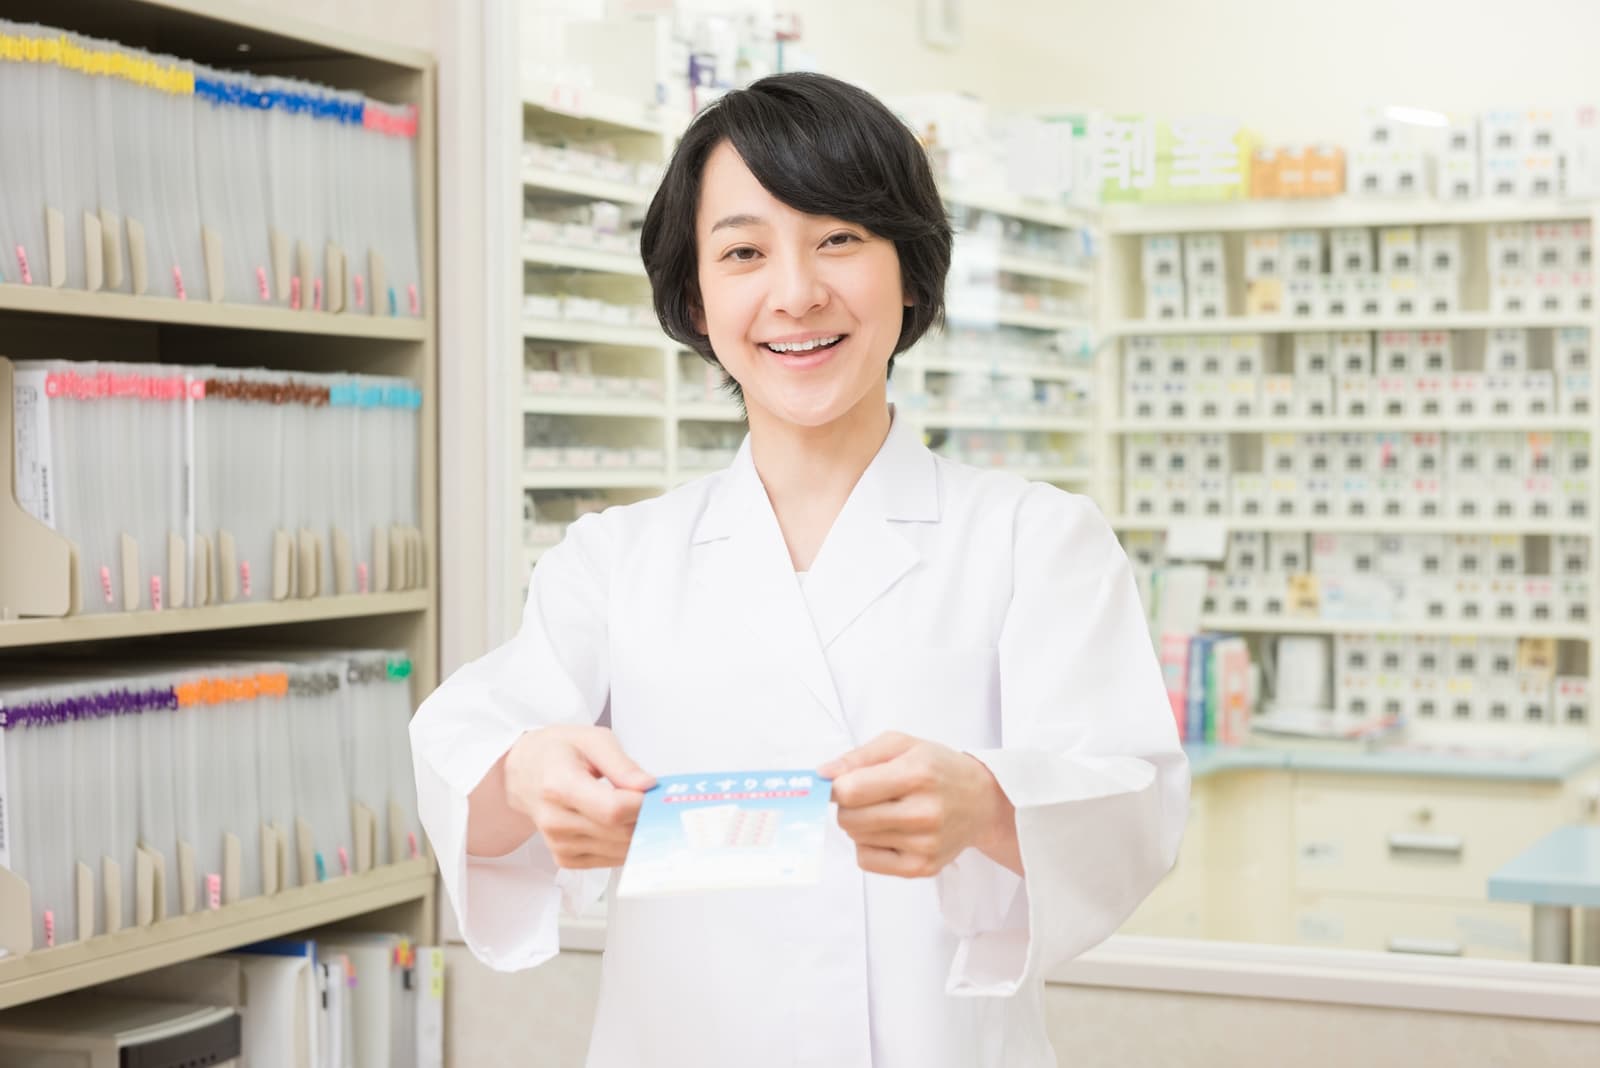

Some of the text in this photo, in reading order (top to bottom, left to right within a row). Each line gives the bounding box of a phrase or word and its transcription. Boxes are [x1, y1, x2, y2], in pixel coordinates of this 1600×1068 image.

[1008, 112, 1241, 190] 剤室
[666, 776, 813, 794] おくすり手帳
